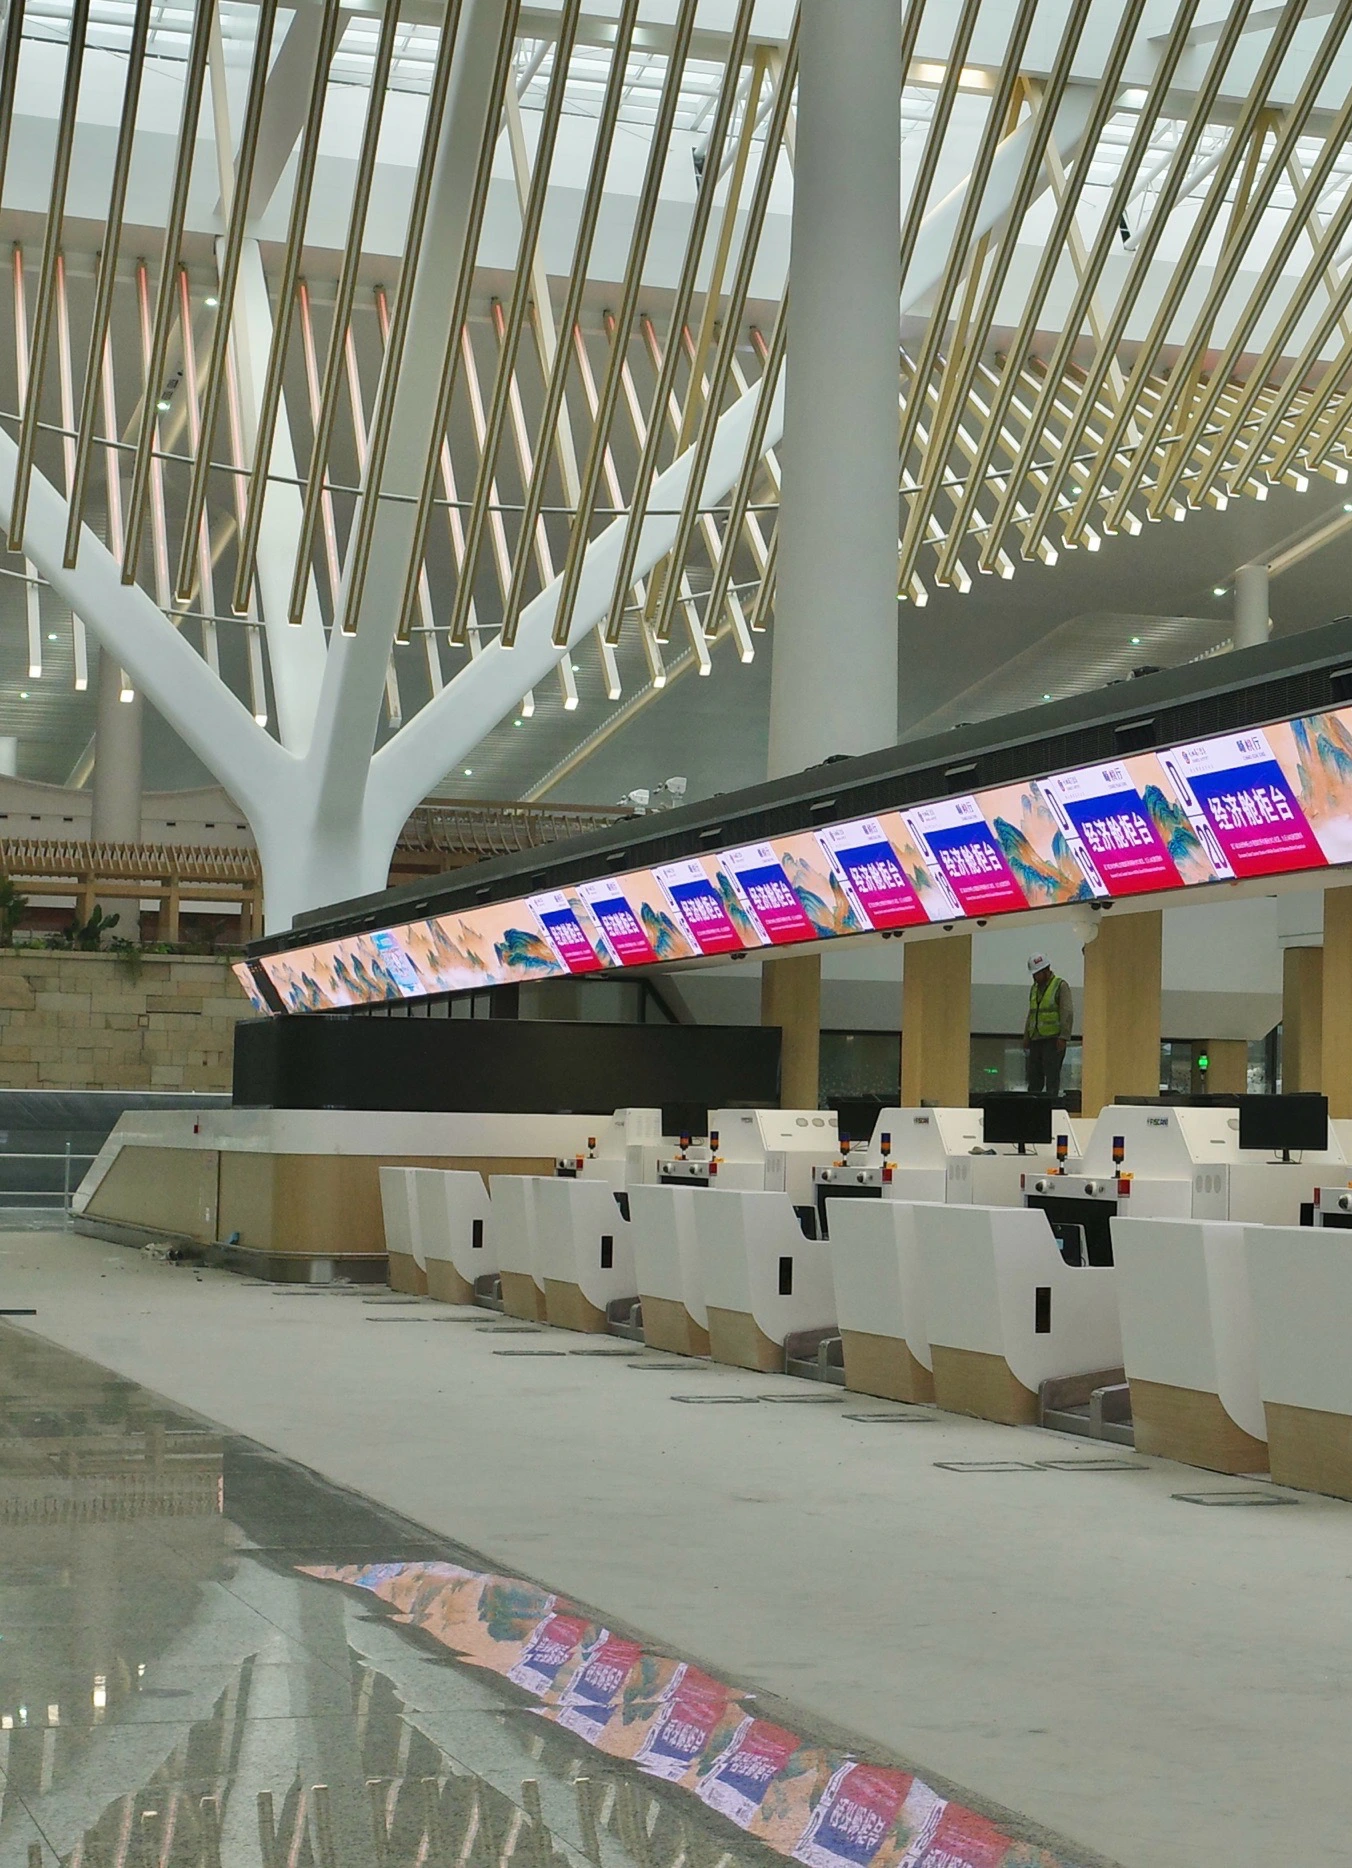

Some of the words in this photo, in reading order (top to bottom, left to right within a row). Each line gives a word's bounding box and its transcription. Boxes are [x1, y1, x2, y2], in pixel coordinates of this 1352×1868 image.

[1165, 761, 1192, 807] D
[1044, 788, 1069, 831] D
[1207, 785, 1295, 830] 经济舱柜台
[1081, 812, 1155, 853] 经济舱柜台
[1195, 825, 1228, 869] 20
[849, 860, 905, 893] 经济舱柜台
[939, 841, 1003, 878] 经济舱柜台
[1074, 844, 1102, 888] 19
[934, 872, 960, 909] 18
